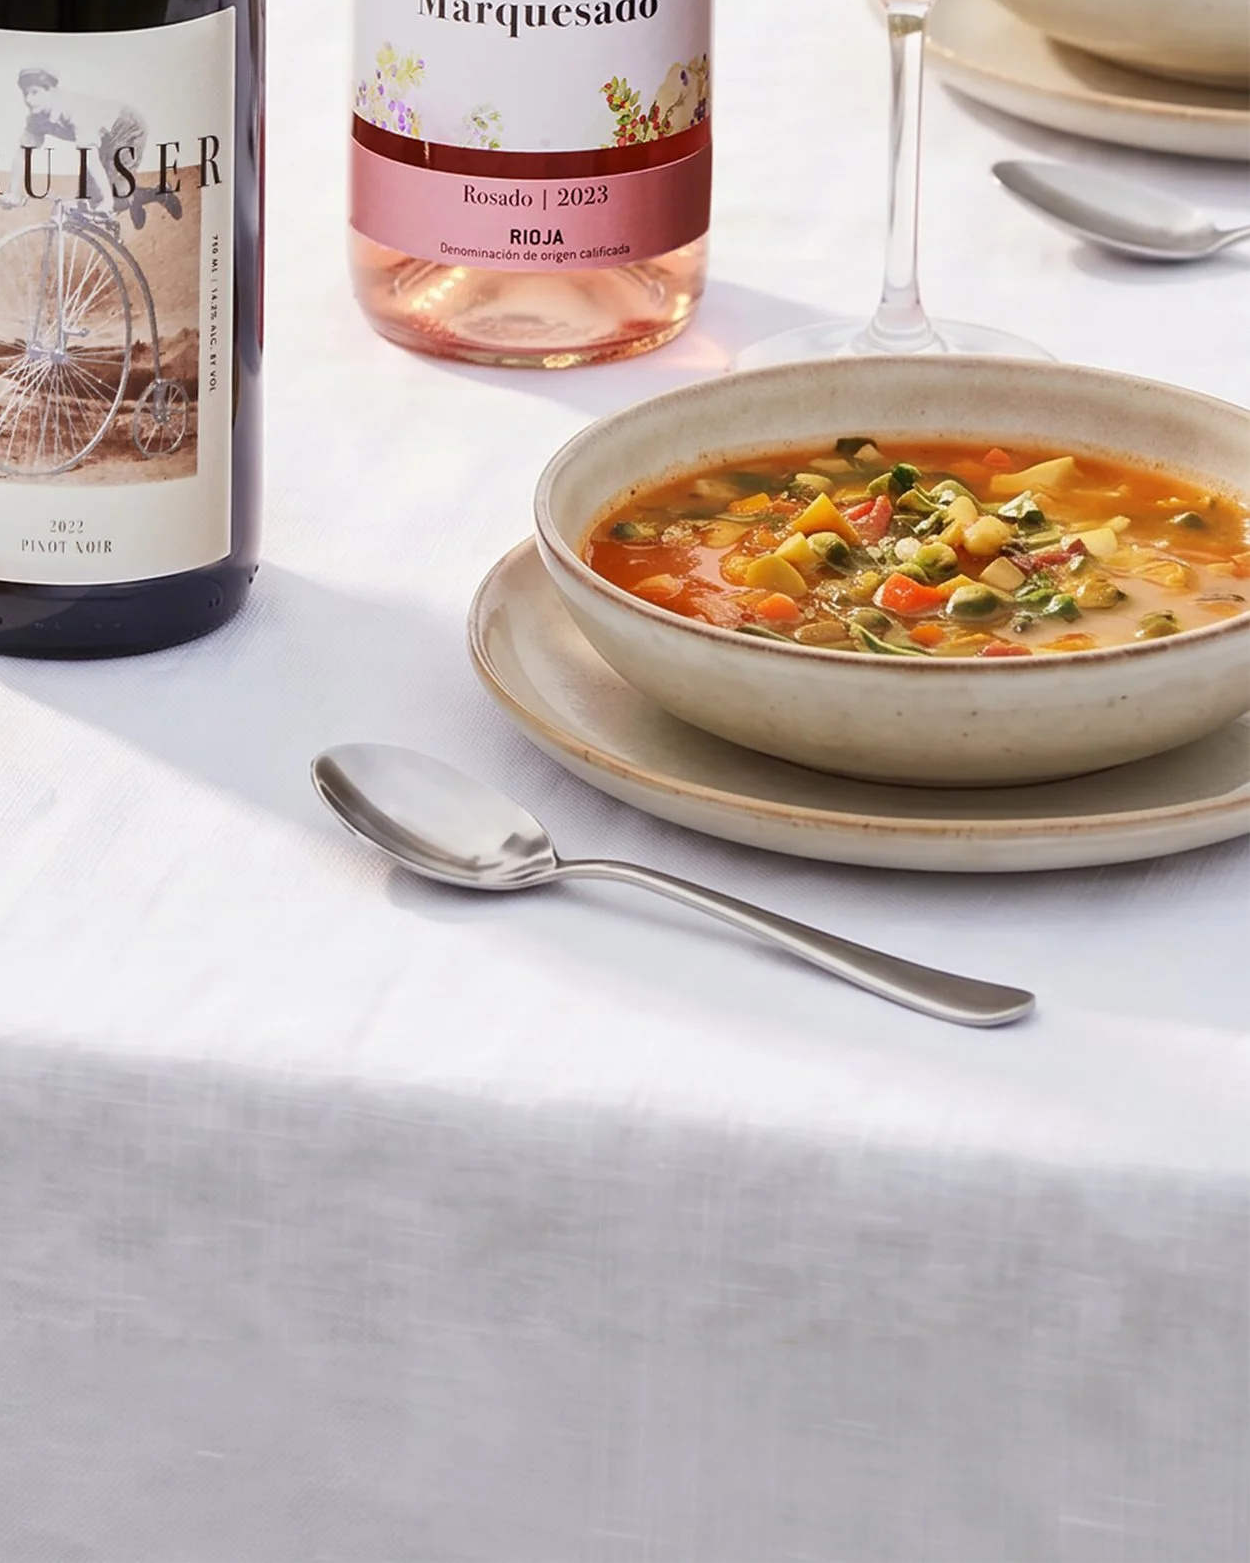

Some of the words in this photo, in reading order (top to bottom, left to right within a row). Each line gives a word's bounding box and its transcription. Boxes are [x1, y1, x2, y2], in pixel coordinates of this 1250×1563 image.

[462, 183, 533, 208] Rosado
[557, 184, 609, 207] 2023
[509, 228, 565, 245] RIOJA
[440, 241, 520, 261] Denominación
[523, 249, 538, 261] de
[540, 250, 578, 264] origen
[579, 243, 631, 260] calificada
[209, 354, 217, 366] BY
[49, 519, 84, 534] 2022
[21, 539, 68, 554] PINOT
[75, 540, 113, 554] NOIR
